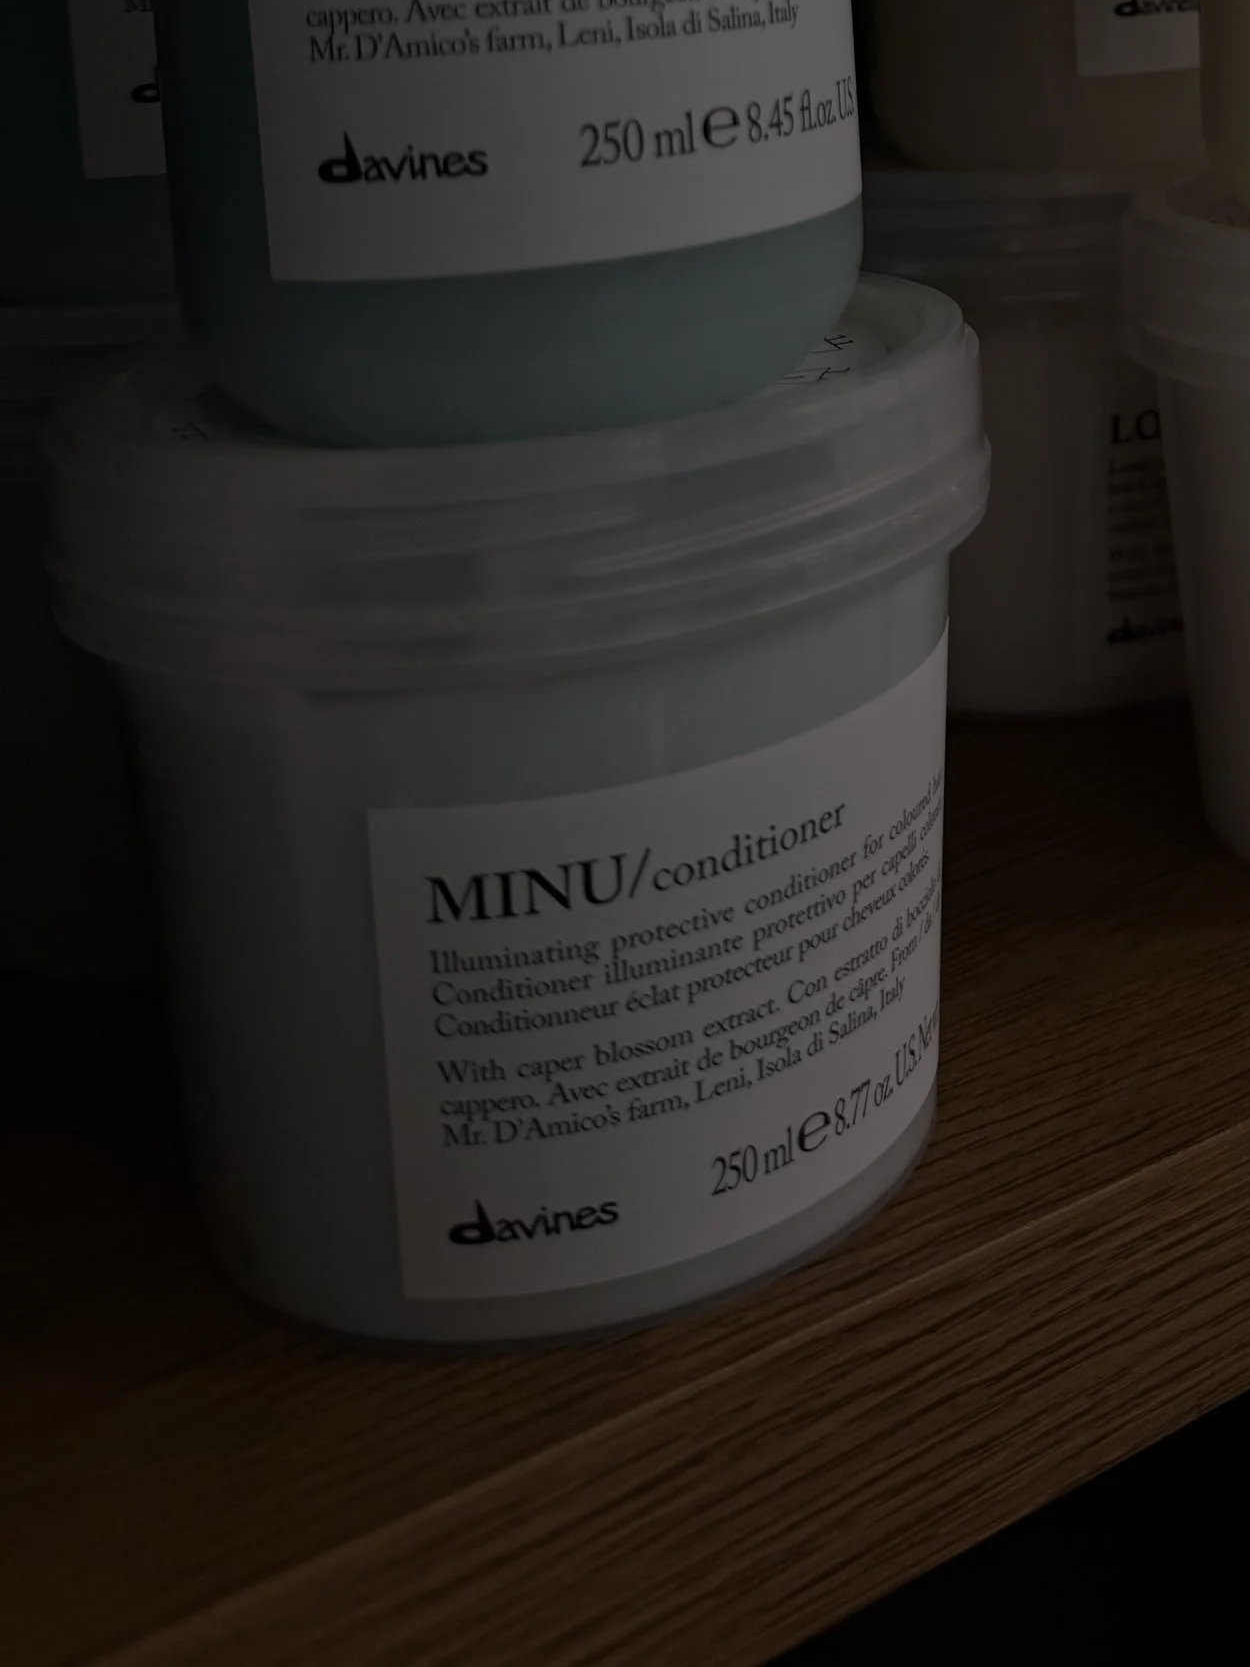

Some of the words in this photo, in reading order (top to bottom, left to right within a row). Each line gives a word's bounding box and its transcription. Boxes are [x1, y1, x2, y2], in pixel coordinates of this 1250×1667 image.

[305, 7, 398, 35] cappero.
[309, 36, 350, 63] Mr.
[356, 27, 481, 61] D'Amico's
[486, 25, 554, 54] farm,
[558, 20, 622, 49] Leni,
[626, 14, 678, 42] Isola
[682, 9, 702, 35] di
[707, 3, 766, 33] Salina,
[318, 129, 490, 184] davines
[579, 117, 645, 169] 250
[653, 109, 699, 160] ml
[746, 94, 796, 145] 8.45
[428, 939, 601, 975] Illuminating
[611, 904, 735, 961] protective
[744, 849, 858, 915] conditioner
[863, 833, 885, 860] for
[888, 781, 932, 842] coloured
[432, 971, 594, 1007] Conditioner
[604, 932, 744, 986] illuminante
[752, 888, 847, 951] protettivo
[852, 867, 877, 905] per
[881, 828, 918, 877] capelli
[434, 998, 620, 1038] Conditionneur
[625, 982, 682, 1014] éclat
[688, 944, 793, 1005] protecteur
[798, 922, 840, 964] pour
[842, 888, 898, 933] cheveux
[437, 1058, 506, 1085] With
[517, 1052, 586, 1083] caper
[593, 1026, 695, 1067] blossom
[702, 998, 780, 1038] extract.
[787, 973, 828, 1005] Con
[833, 935, 889, 983] estratto
[440, 1091, 541, 1122] cappero.
[549, 1081, 609, 1106] Avec
[616, 1057, 692, 1094] extrait
[696, 1046, 724, 1072] de
[729, 1009, 821, 1062] bourgeon
[441, 1122, 487, 1148] Mr.
[493, 1104, 622, 1144] D'Amico's
[627, 1094, 691, 1123] farm,
[693, 1066, 753, 1104] Leni,
[756, 1047, 802, 1082] Isola
[829, 1003, 879, 1045] Salina,
[880, 975, 907, 1014] Italy
[450, 1198, 620, 1245] davines
[711, 1142, 758, 1197] 250
[764, 1125, 795, 1176] ml
[834, 1076, 872, 1137] 8.77
